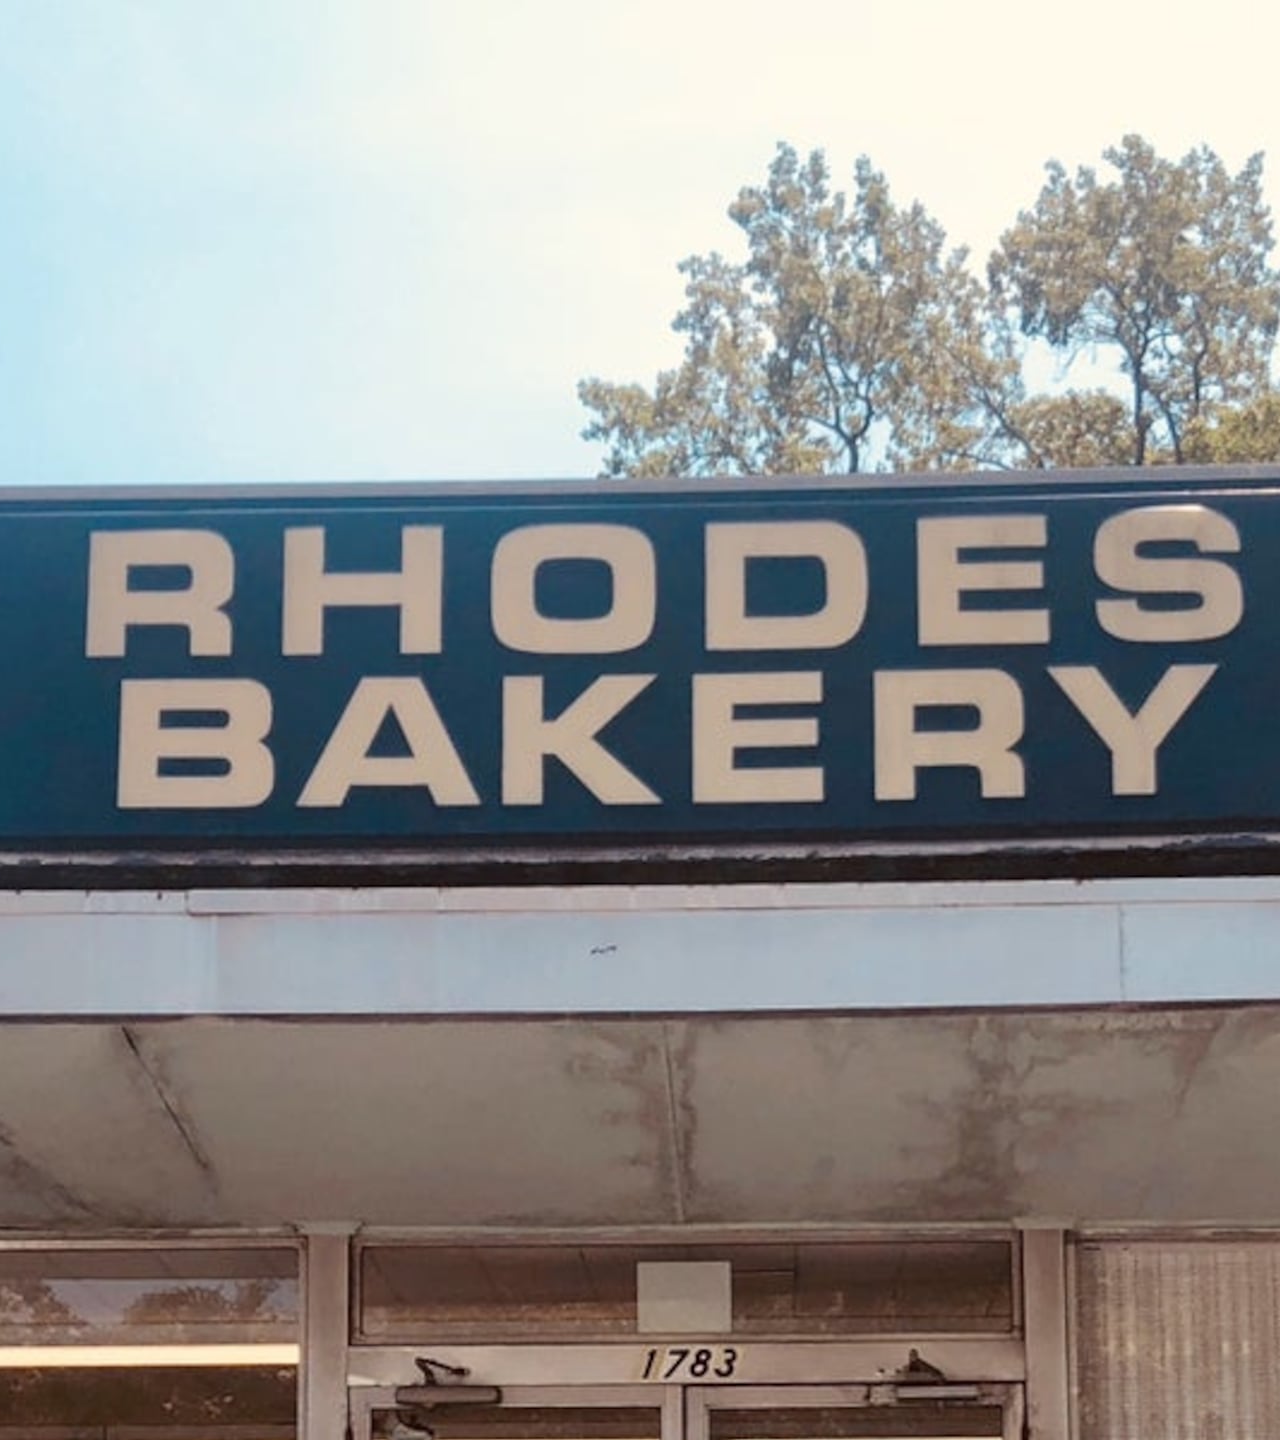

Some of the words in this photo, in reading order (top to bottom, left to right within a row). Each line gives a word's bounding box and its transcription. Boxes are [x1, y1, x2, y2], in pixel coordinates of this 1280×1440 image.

[85, 504, 1246, 660] RHODES
[115, 661, 1220, 810] BAKERY
[642, 1348, 737, 1379] 1783
